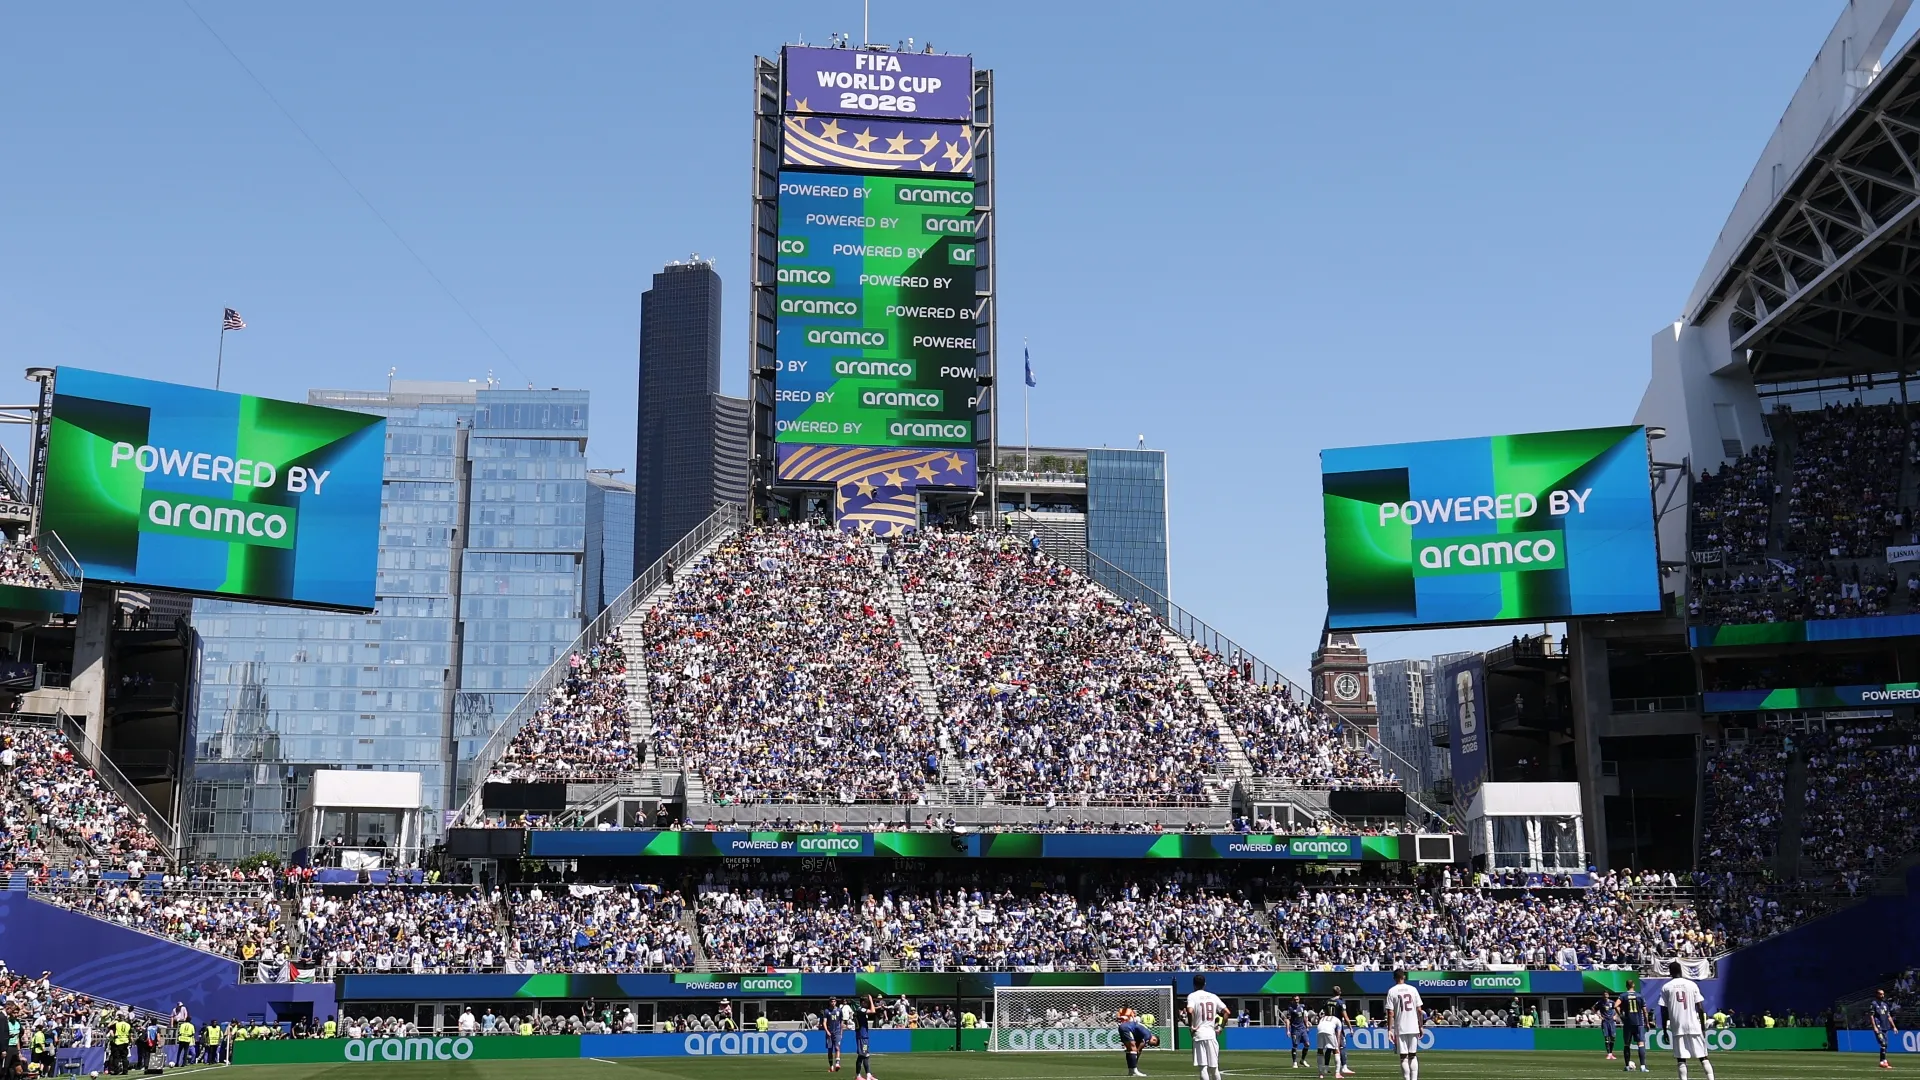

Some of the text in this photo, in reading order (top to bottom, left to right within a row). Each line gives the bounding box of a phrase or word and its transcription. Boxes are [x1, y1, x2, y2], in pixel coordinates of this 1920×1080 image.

[856, 54, 901, 72] FIFA
[817, 71, 941, 93] WORLD CUP
[840, 93, 916, 112] 2026
[779, 184, 973, 204] POWERED BY aramco
[806, 214, 875, 227] POWERED
[880, 218, 898, 228] BY
[833, 244, 902, 257] POWERED
[908, 248, 926, 258] BY
[778, 269, 952, 288] amco POWERED BY
[781, 300, 976, 319] aramco POWERED BY
[808, 330, 884, 346] aramco
[788, 361, 807, 372] BY
[836, 361, 912, 376] aramco
[776, 390, 810, 402] ERED
[816, 392, 834, 402] BY
[863, 392, 939, 407] aramco
[776, 421, 966, 438] OWERED BY aramco
[111, 441, 330, 494] POWERED BY
[1379, 488, 1592, 526] POWERED BY
[149, 500, 287, 539] aramco
[1420, 539, 1555, 569] aramco
[1862, 690, 1920, 700] POWERED
[1462, 742, 1478, 754] 2026
[732, 839, 858, 849] POWERED BY aramco
[1293, 842, 1347, 852] aramco
[686, 979, 792, 990] POWERED BY aramco
[1419, 977, 1520, 987] POWERED BY aramco
[1398, 994, 1412, 1012] 12
[1629, 1000, 1638, 1012] 11
[1676, 991, 1687, 1010] 4
[1200, 1002, 1213, 1021] 18
[344, 1038, 473, 1061] aramco
[684, 1032, 807, 1054] aramco
